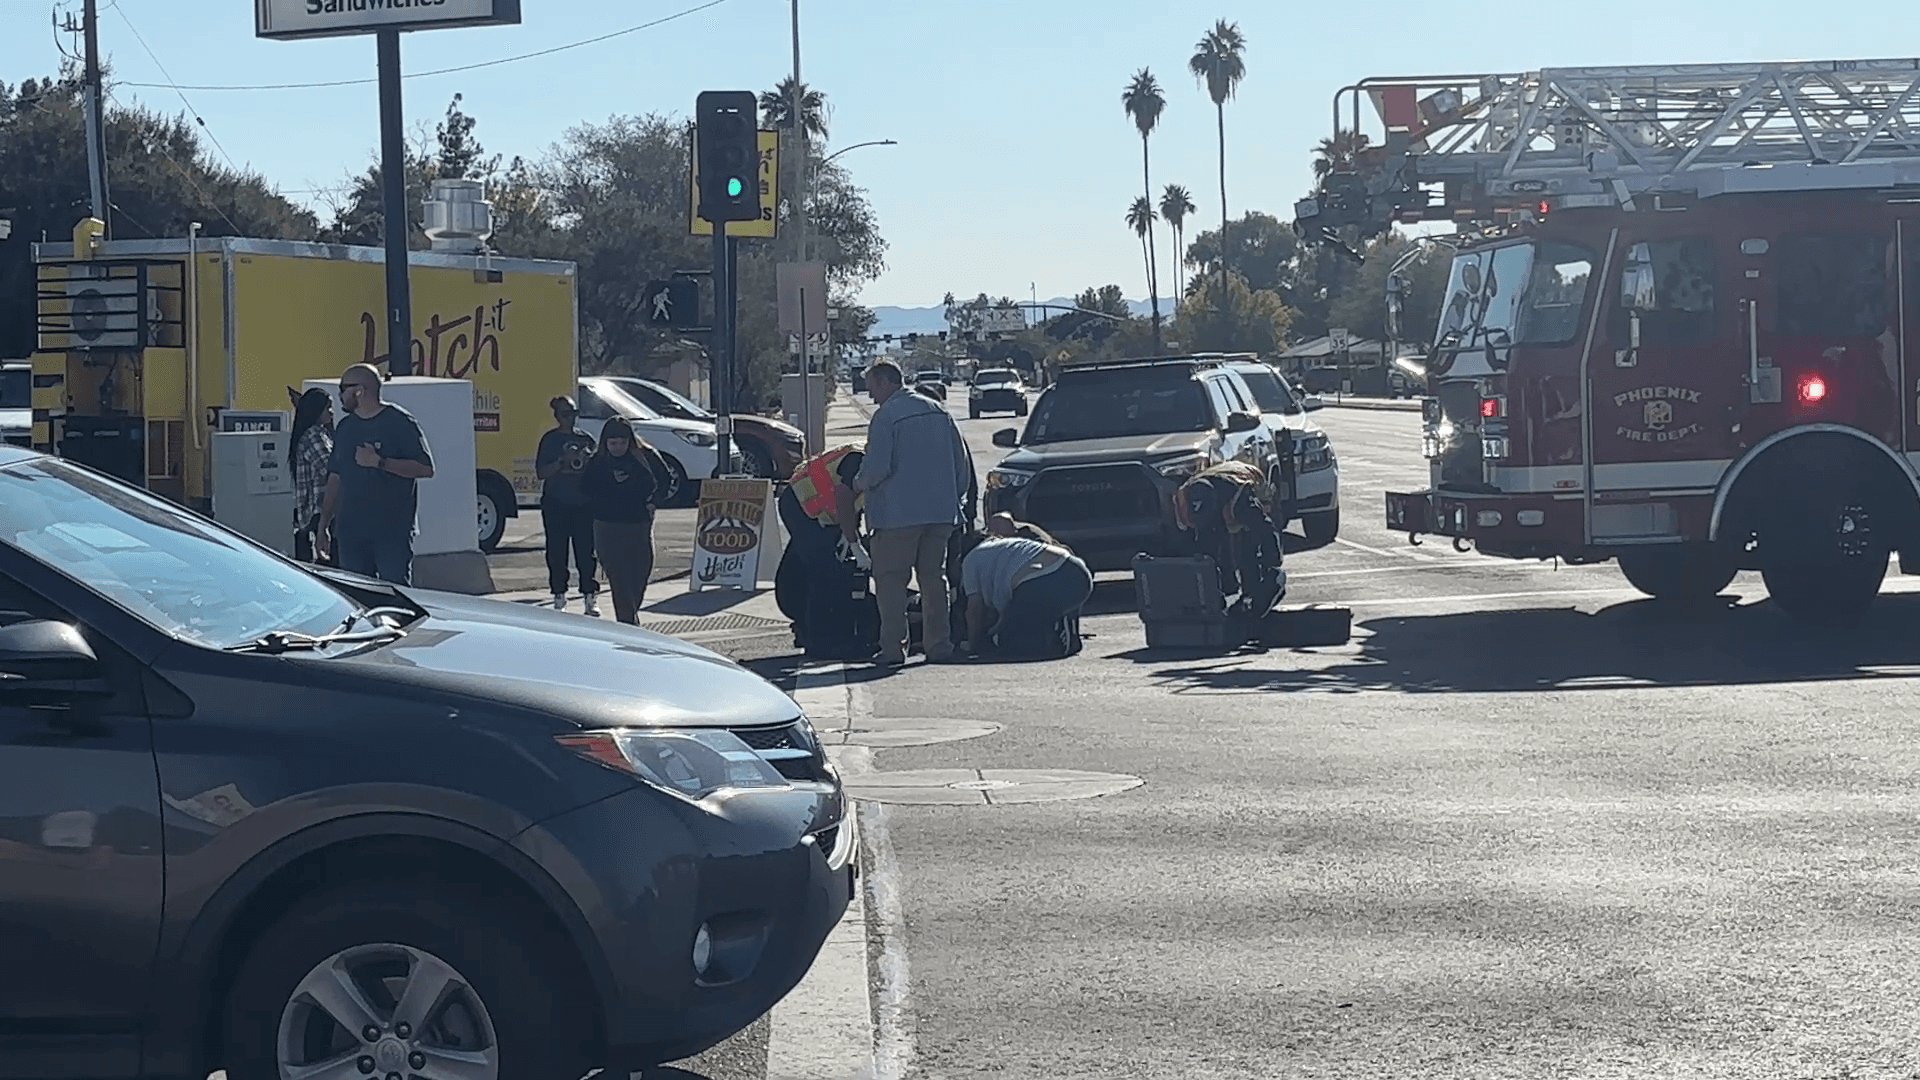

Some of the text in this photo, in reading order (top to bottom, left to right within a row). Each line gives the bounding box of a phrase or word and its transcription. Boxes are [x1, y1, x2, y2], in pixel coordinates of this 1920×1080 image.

[1333, 339, 1346, 349] 35
[473, 390, 500, 410] hile
[1613, 386, 1702, 407] PHOENIX
[1616, 426, 1652, 442] FIRE
[1071, 482, 1113, 493] TOYOTA
[705, 532, 751, 548] FOOD
